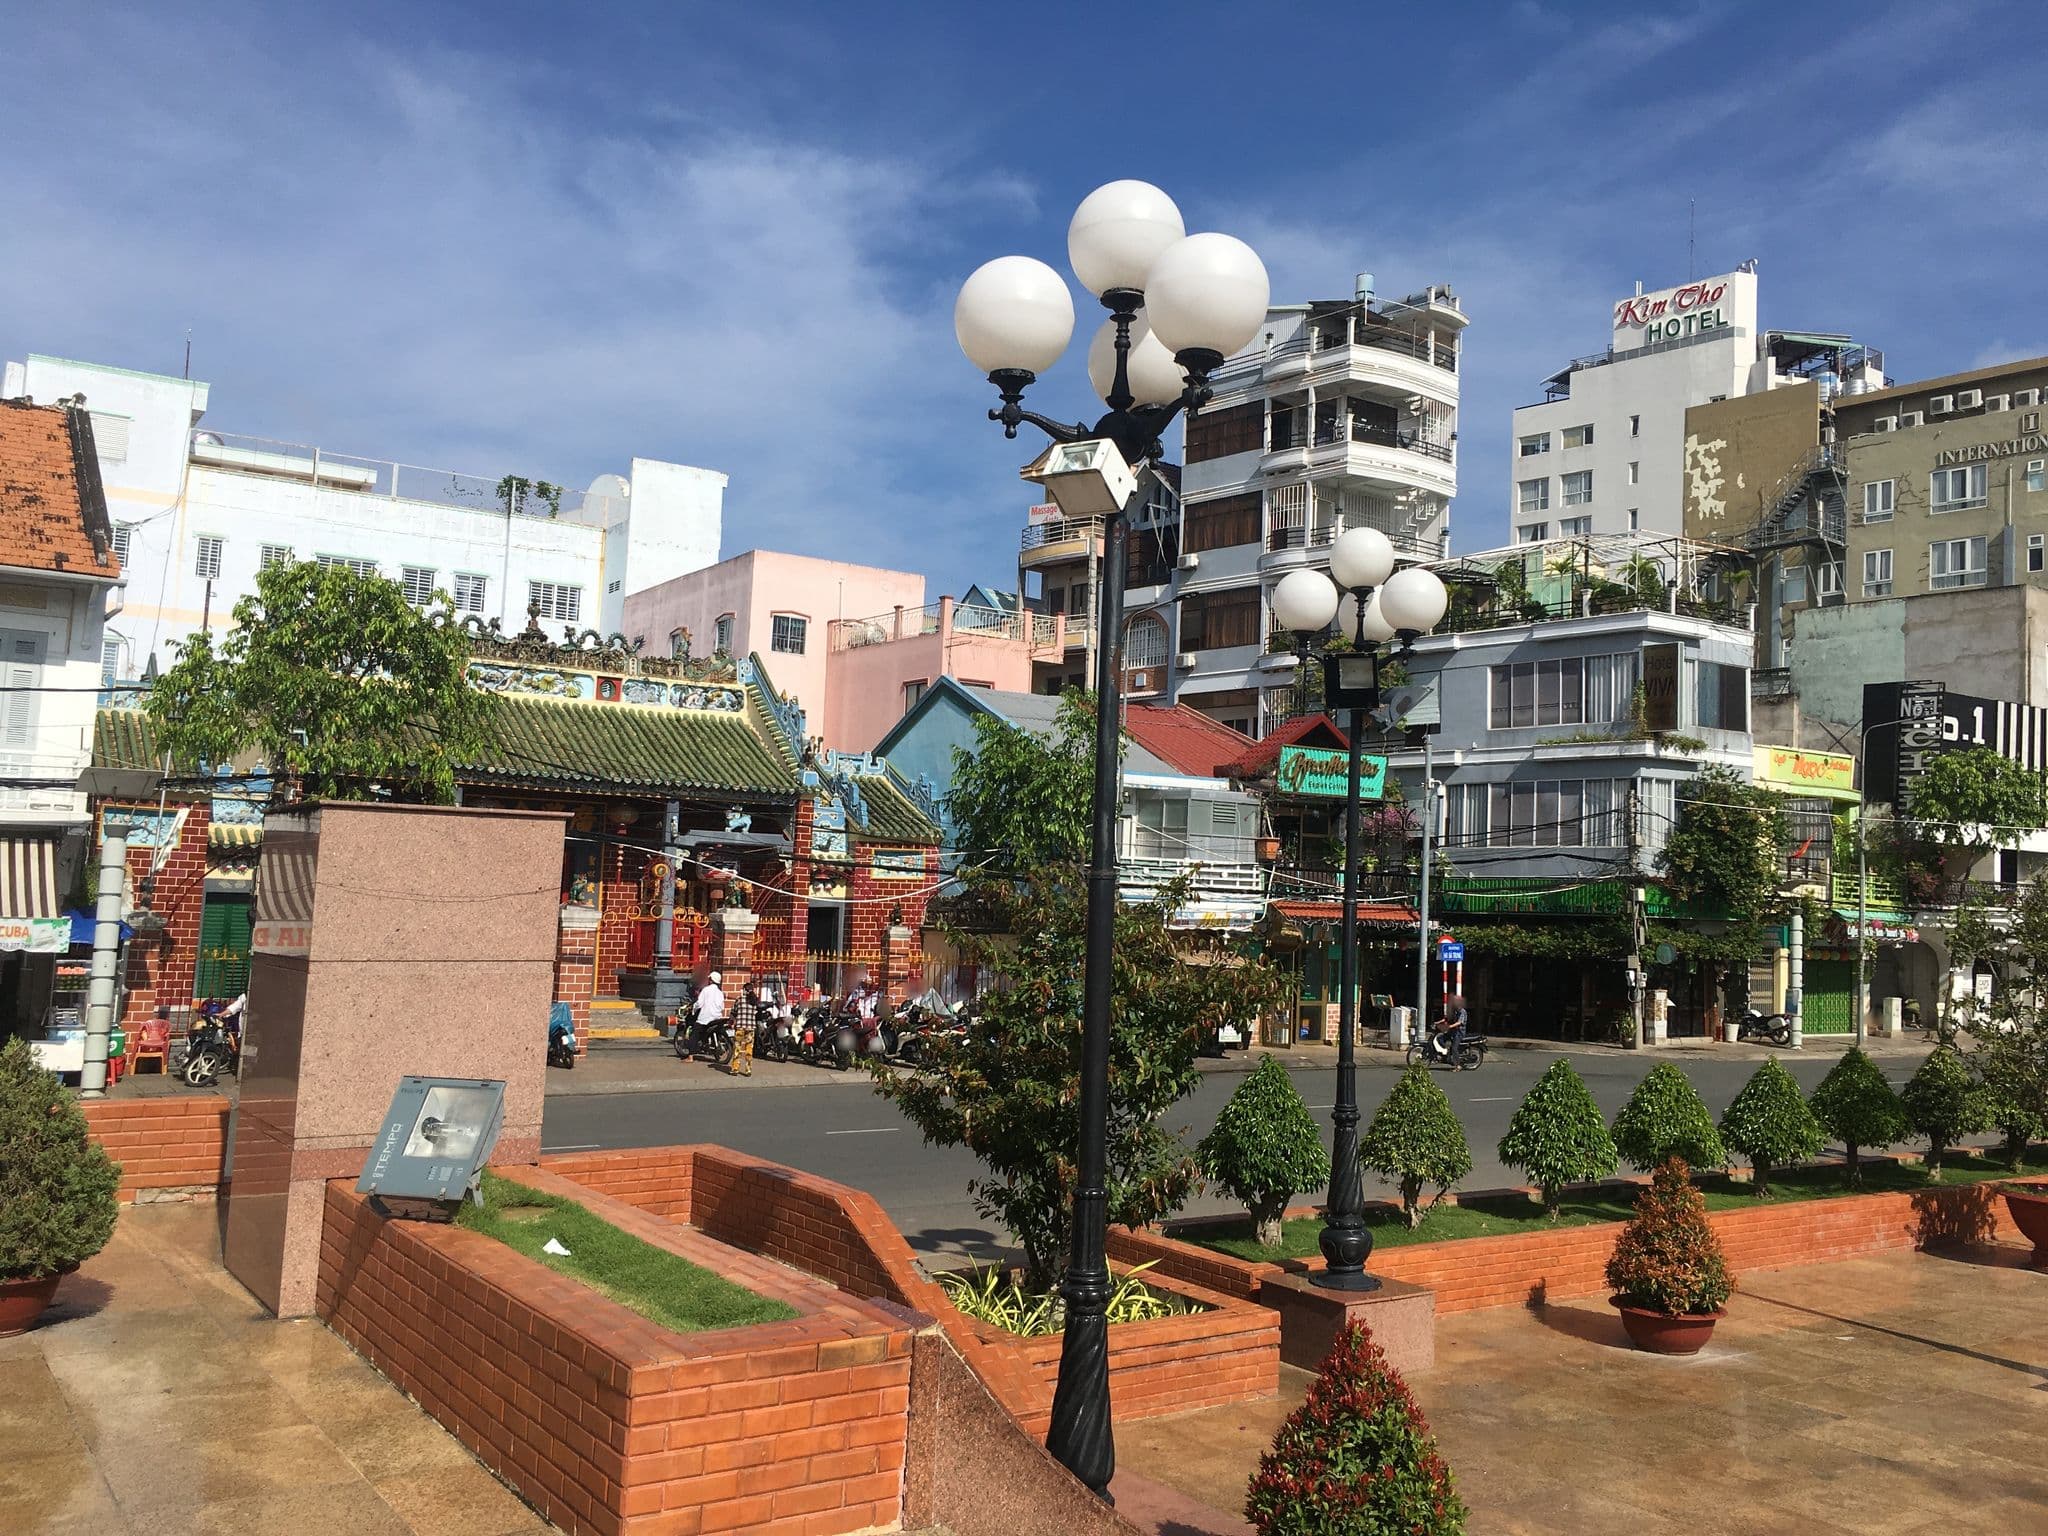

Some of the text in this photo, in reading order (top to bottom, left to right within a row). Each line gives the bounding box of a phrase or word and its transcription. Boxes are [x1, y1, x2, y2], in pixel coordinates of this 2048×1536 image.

[1617, 296, 1668, 325] Kim
[1648, 308, 1728, 342] HOTEL
[1031, 506, 1057, 516] Massage
[374, 1123, 402, 1173] TEMPO
